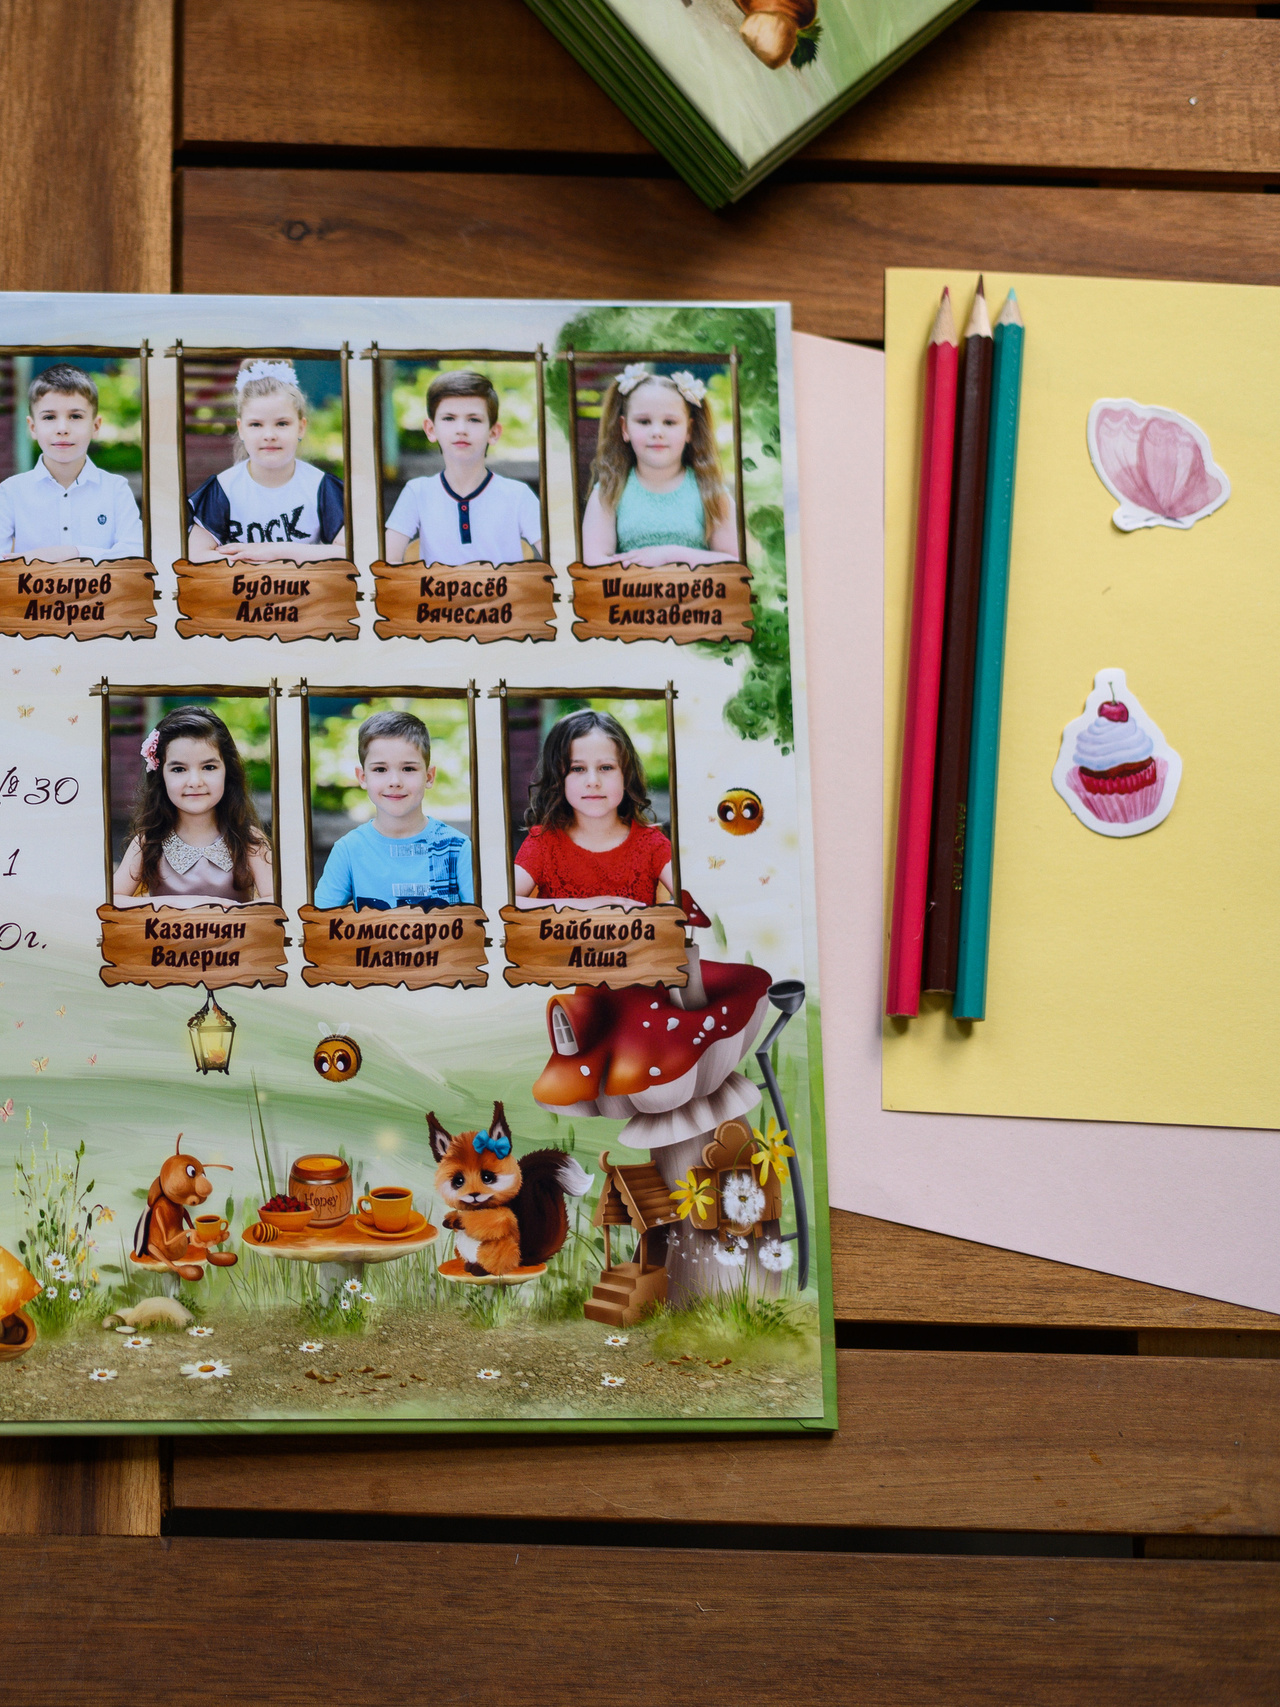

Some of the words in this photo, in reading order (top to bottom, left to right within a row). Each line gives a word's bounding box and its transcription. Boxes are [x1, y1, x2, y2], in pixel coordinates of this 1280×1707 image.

[228, 504, 311, 544] ROCK
[17, 573, 112, 598] Козырев
[232, 574, 311, 599] Будник
[420, 576, 508, 602] Карасёв
[602, 578, 726, 603] Шишкарёва
[24, 599, 105, 625] Андрей
[235, 601, 299, 623] Алёна
[416, 602, 513, 624] Вячеслав
[608, 604, 723, 625] Елизавета
[954, 802, 966, 856] FANCY
[2, 848, 20, 876] 1
[144, 917, 246, 941] Казанчян
[328, 917, 464, 943] Комиссаров
[539, 918, 656, 941] Байбикова
[151, 945, 240, 972] Валерия
[355, 946, 439, 969] Платон
[568, 945, 627, 968] Айша
[304, 1192, 338, 1207] Honey
